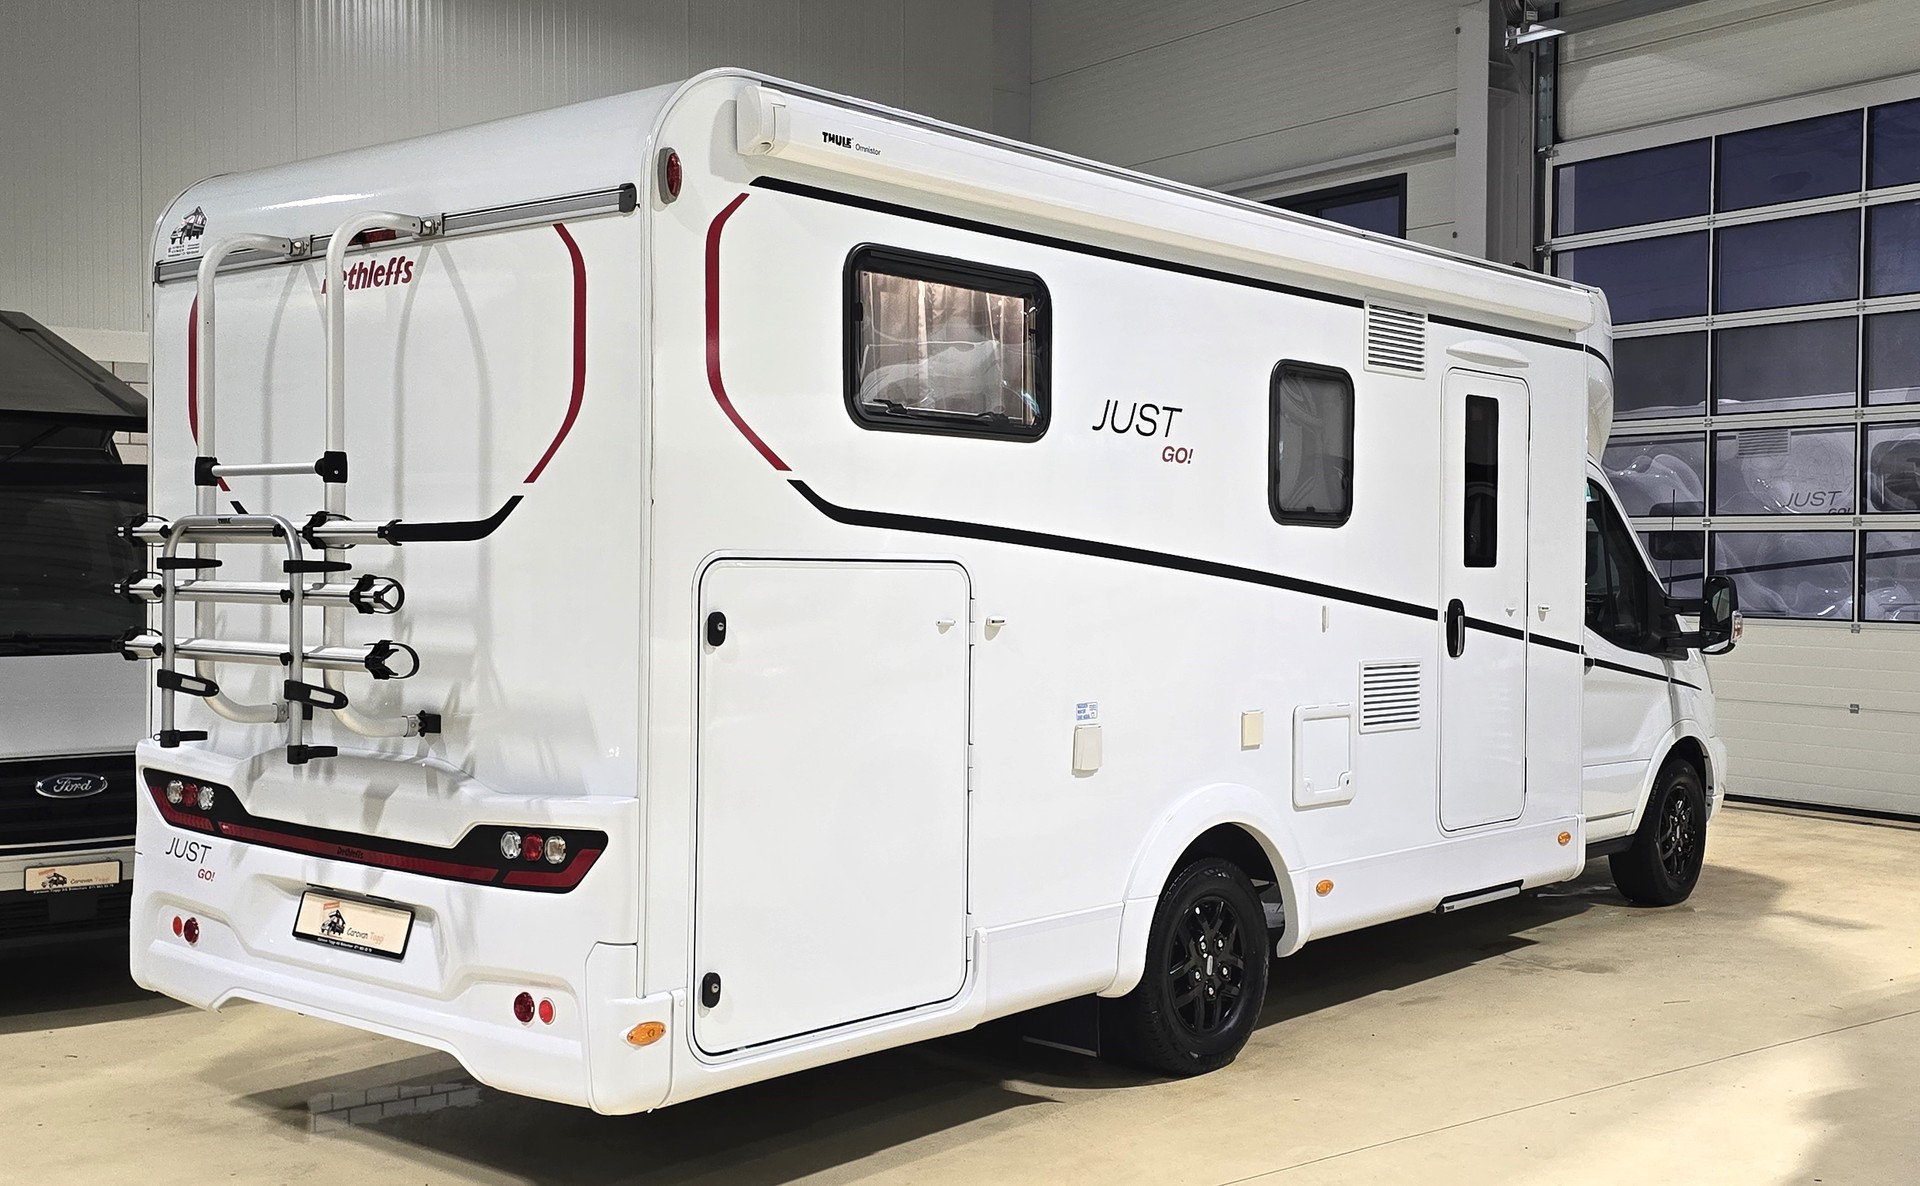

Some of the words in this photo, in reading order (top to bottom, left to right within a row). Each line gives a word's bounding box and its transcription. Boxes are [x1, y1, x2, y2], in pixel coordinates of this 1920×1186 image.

[821, 131, 852, 149] THULE
[855, 143, 881, 156] Omnistor
[321, 256, 414, 294] thleffs
[1092, 399, 1183, 438] JUST
[1161, 445, 1194, 464] GO!
[1782, 490, 1842, 508] JUST
[53, 776, 92, 793] Ford
[165, 837, 212, 864] JUST
[197, 868, 216, 882] GO!
[346, 927, 369, 940] Caravan
